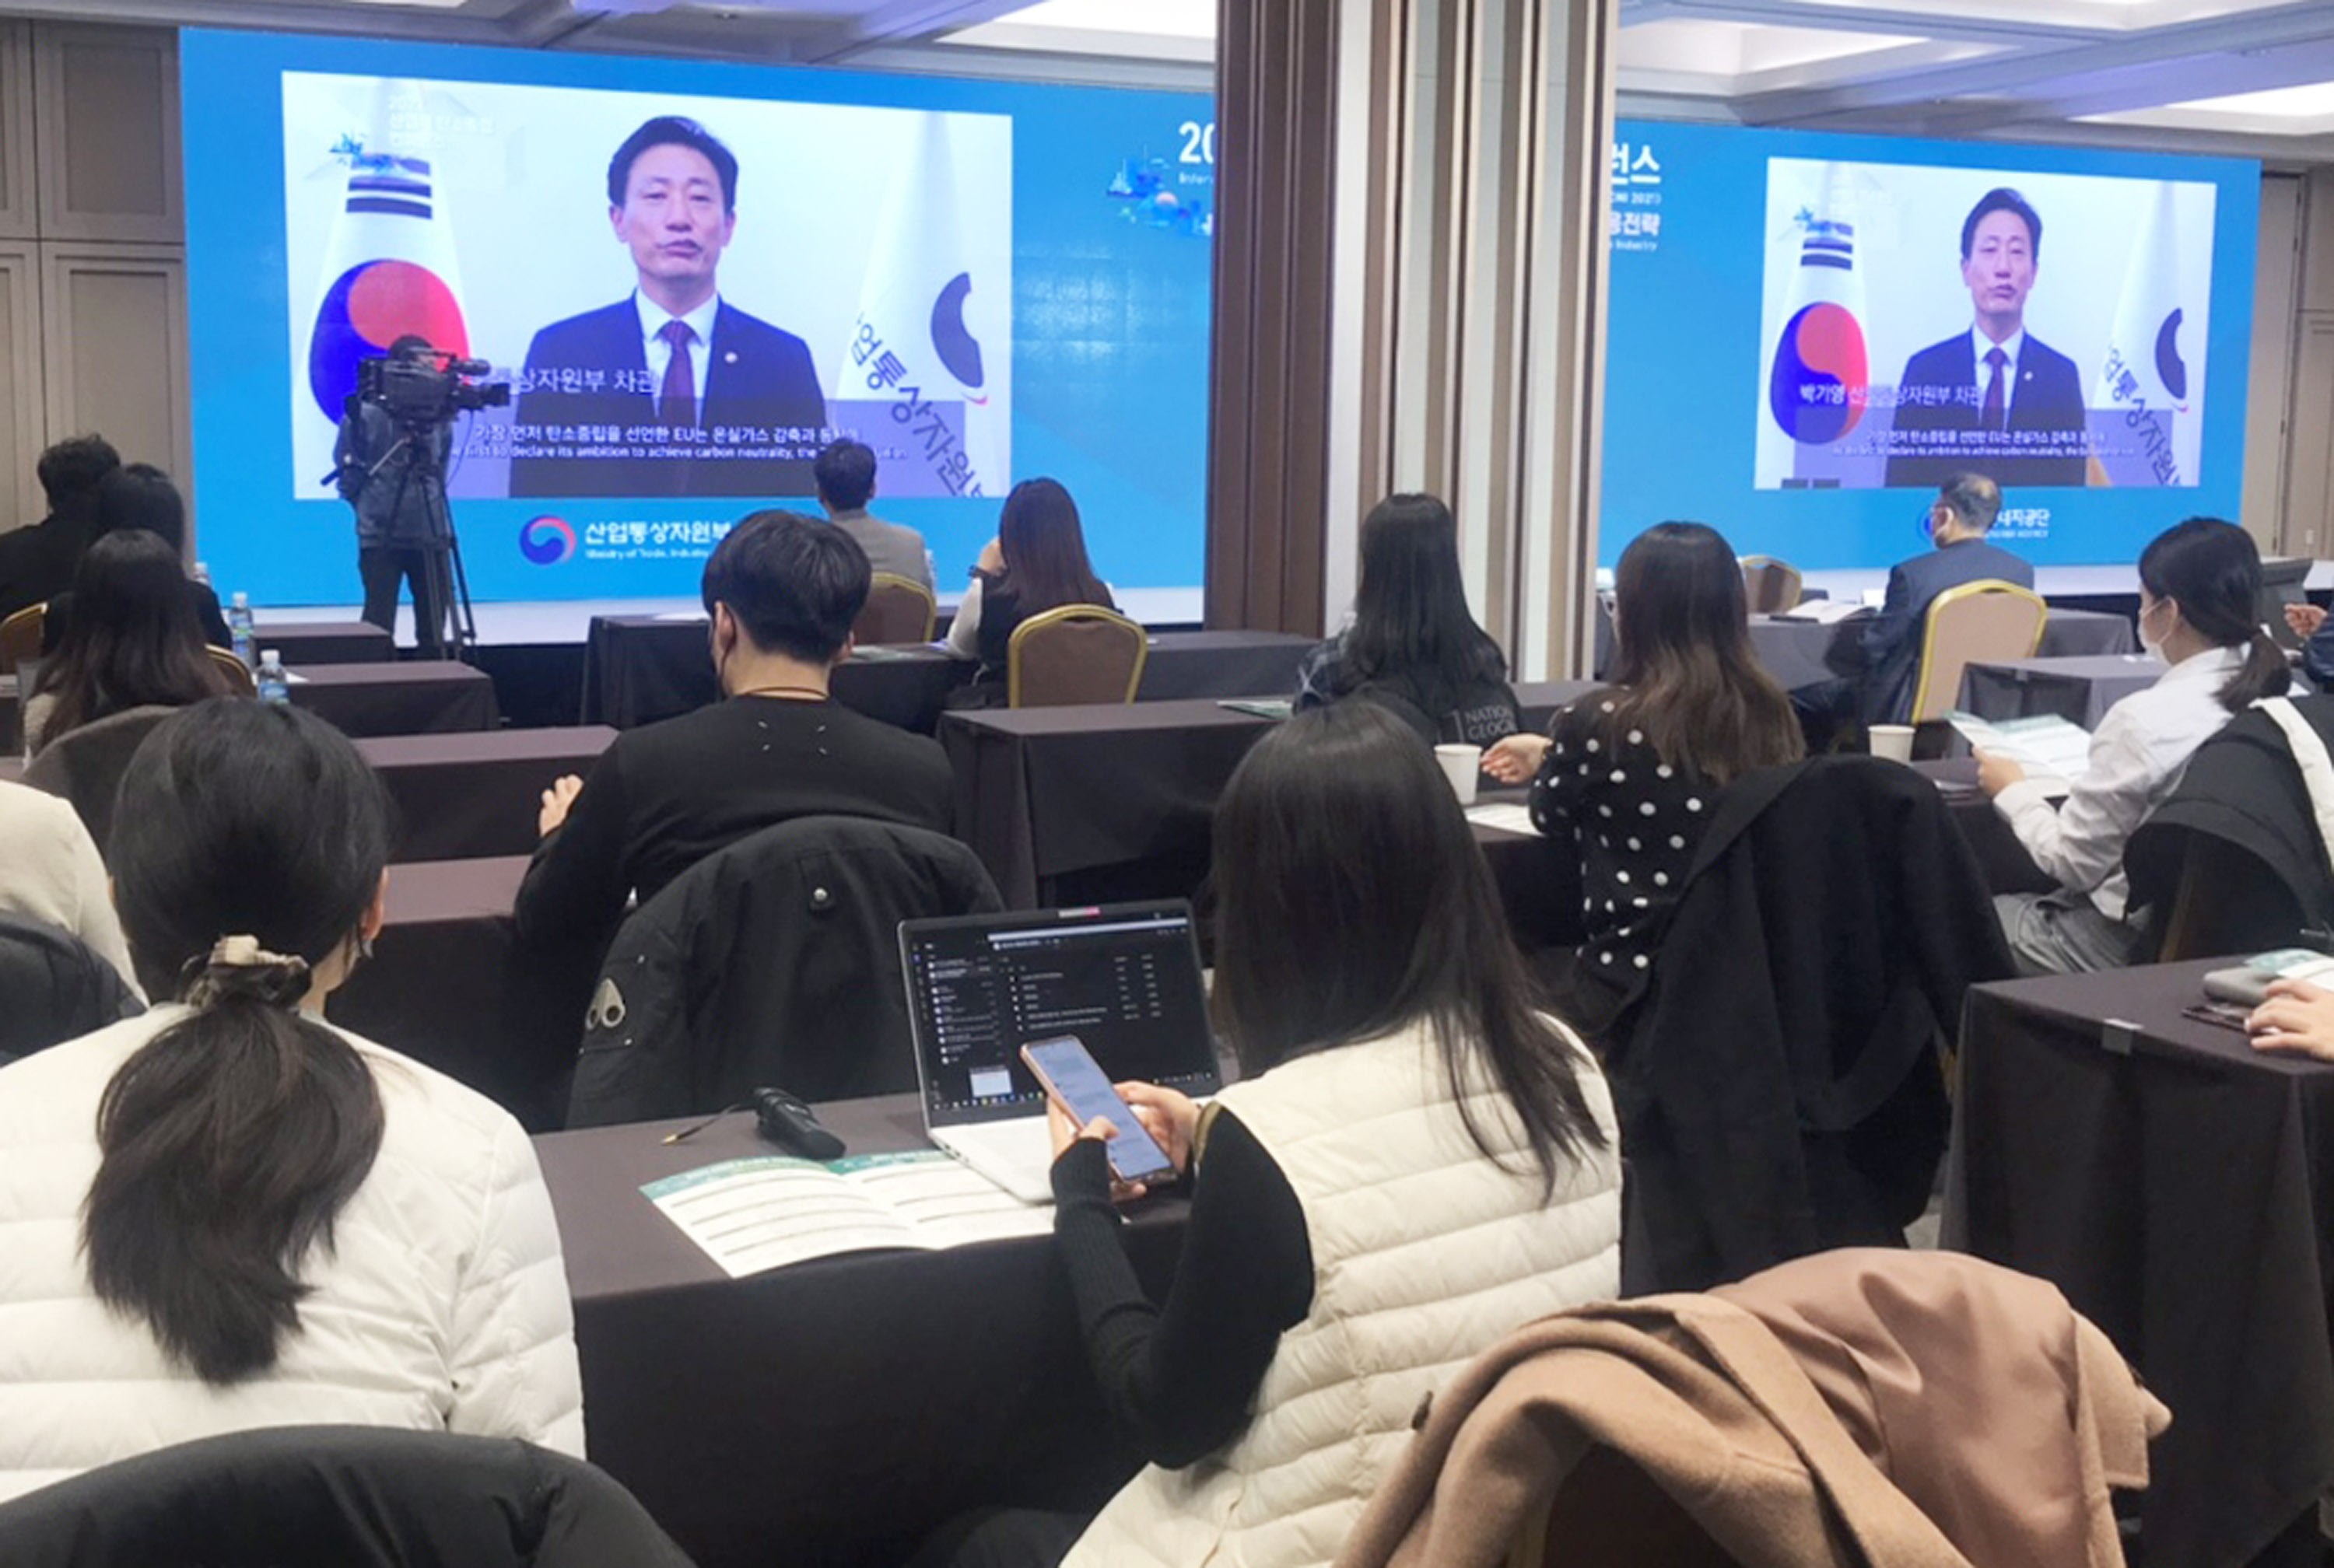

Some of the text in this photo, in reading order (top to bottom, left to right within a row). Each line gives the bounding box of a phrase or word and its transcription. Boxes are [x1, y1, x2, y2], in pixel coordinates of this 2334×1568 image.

[576, 446, 629, 457] ambition
[632, 446, 646, 457] to
[648, 446, 692, 457] achieve
[694, 446, 734, 457] carbon
[585, 521, 733, 544] 산업통상자원부
